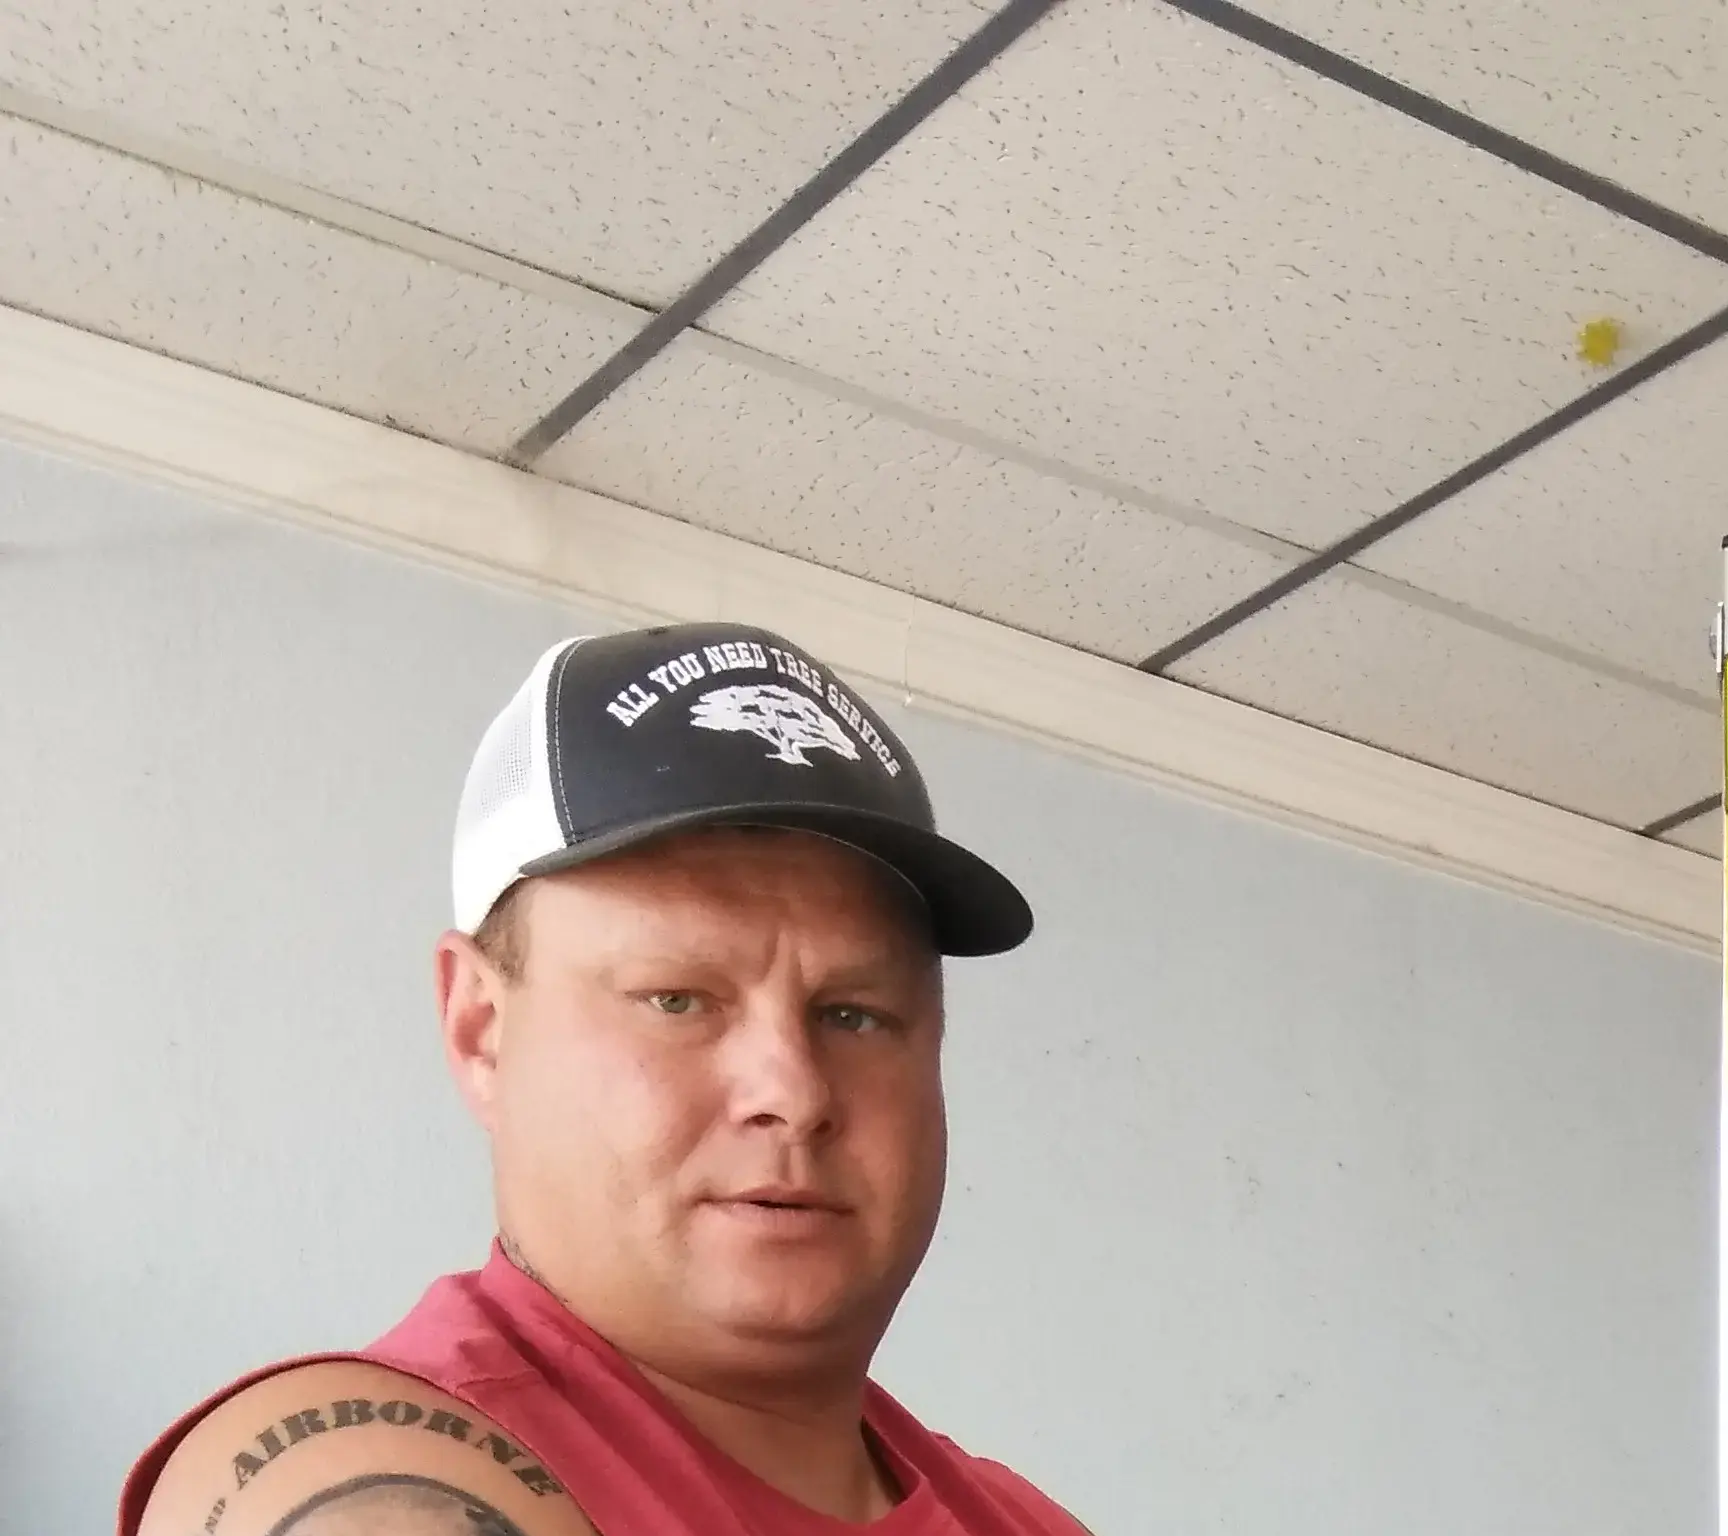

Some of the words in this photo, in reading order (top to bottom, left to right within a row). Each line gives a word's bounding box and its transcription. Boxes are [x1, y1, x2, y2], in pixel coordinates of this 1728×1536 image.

[606, 682, 659, 728] ALL
[646, 651, 706, 694] YOU
[702, 640, 768, 674] NEED
[769, 646, 825, 698] TREE
[825, 682, 902, 779] SERVICE
[230, 1397, 564, 1499] AIRBORNE
